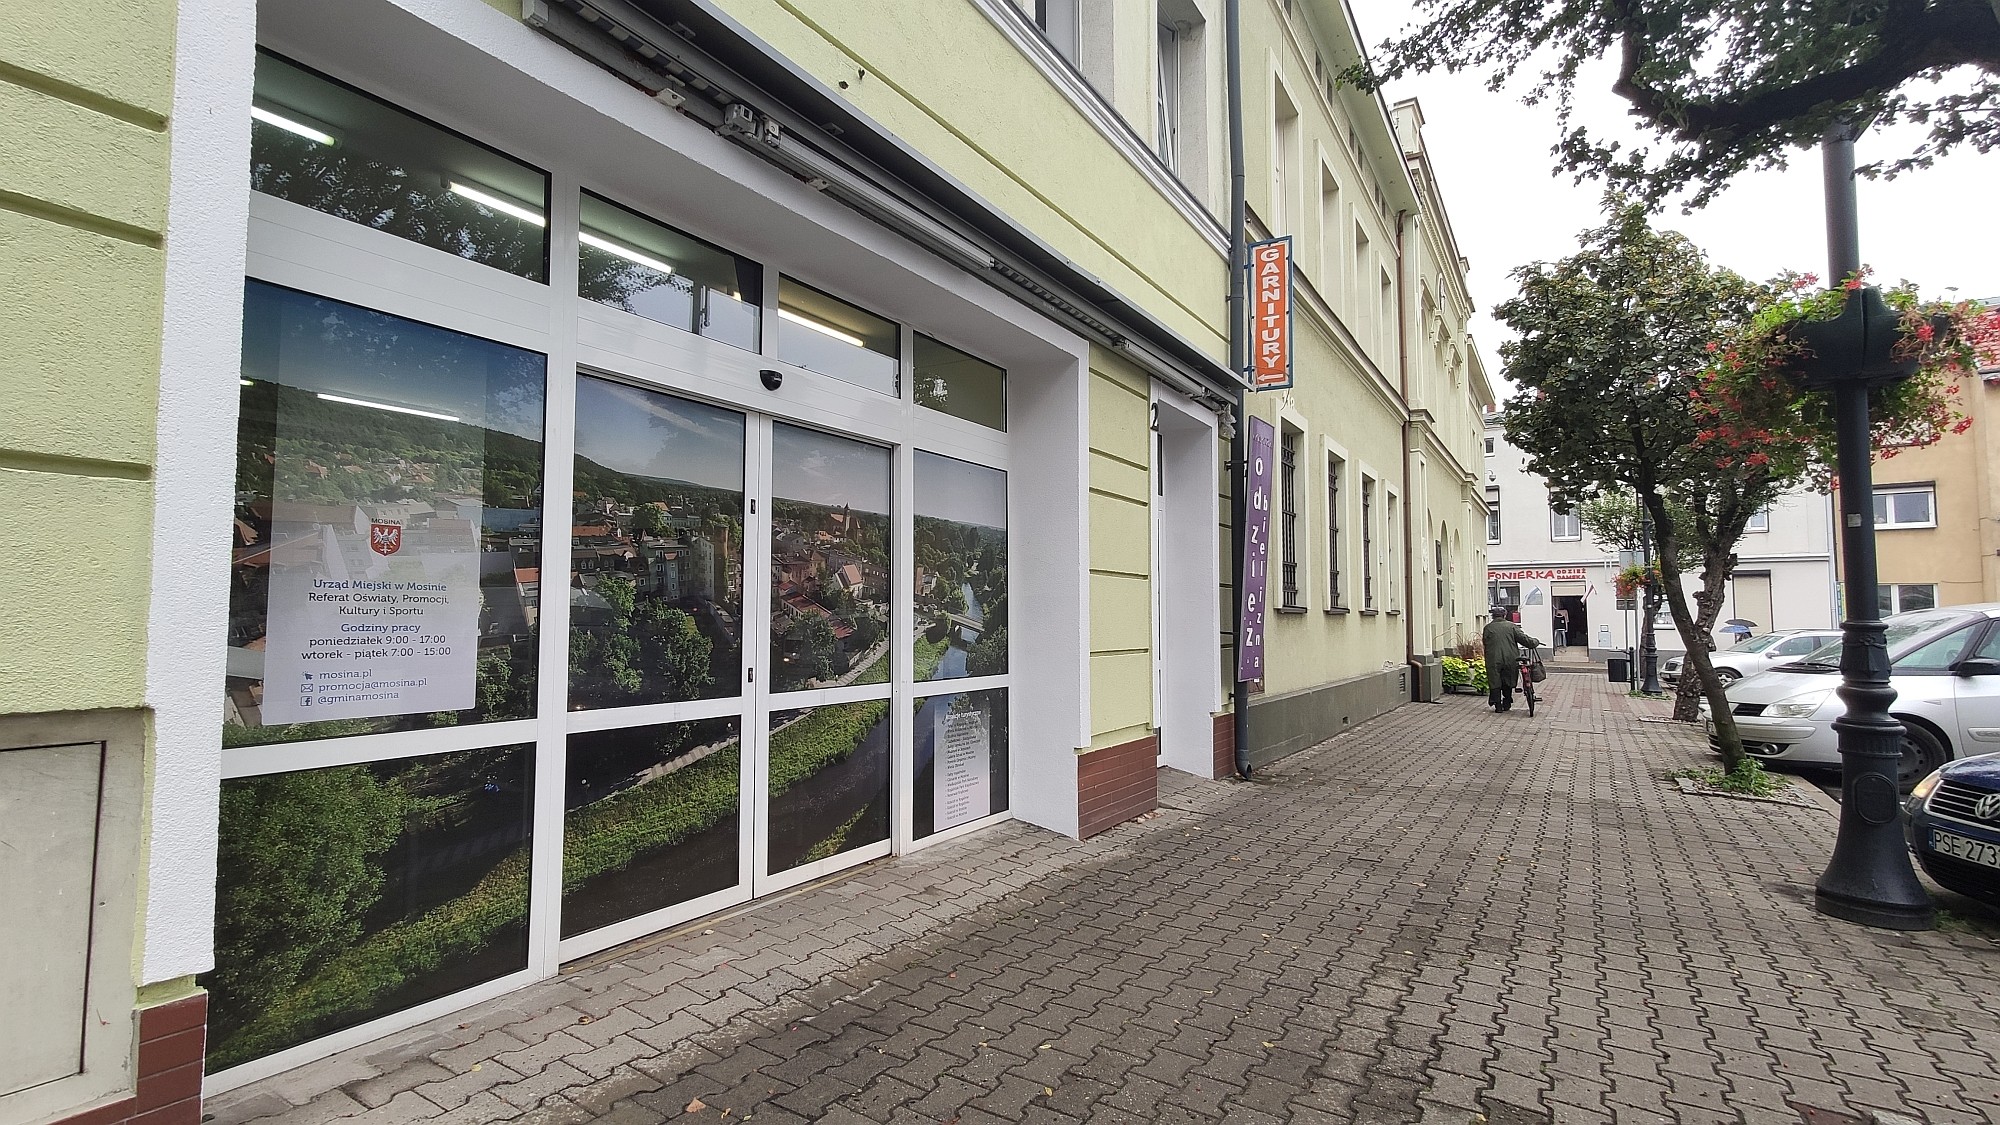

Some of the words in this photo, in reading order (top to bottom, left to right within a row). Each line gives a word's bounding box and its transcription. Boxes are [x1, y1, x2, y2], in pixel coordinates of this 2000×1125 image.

[1261, 248, 1281, 368] GARNITURY
[1150, 402, 1159, 431] 2
[1245, 457, 1264, 647] odzież
[313, 579, 349, 590] Urząd
[352, 580, 391, 591] Miejski
[407, 582, 447, 591] Mosinie
[1254, 494, 1268, 668] bielizna
[308, 592, 349, 602] Referat
[353, 593, 399, 604] Oświaty,
[402, 594, 449, 605] Promocji,
[339, 606, 380, 616] Kultury
[389, 606, 424, 616] Sportu
[341, 623, 388, 633] Godziny
[391, 625, 421, 633] pracy
[309, 635, 383, 647] poniedziałek
[385, 635, 409, 644] 9:00
[419, 635, 446, 644] 17:00
[301, 650, 343, 659] wtorek
[354, 648, 388, 660] piątek
[391, 647, 413, 657] 7:00
[424, 647, 451, 656] 15:00
[319, 669, 372, 680] mosina.pl
[318, 678, 427, 693] promocja@mosina.pl
[318, 691, 399, 705] @gminamosina
[1935, 831, 1961, 857] PSE
[1965, 840, 2000, 868] 273
